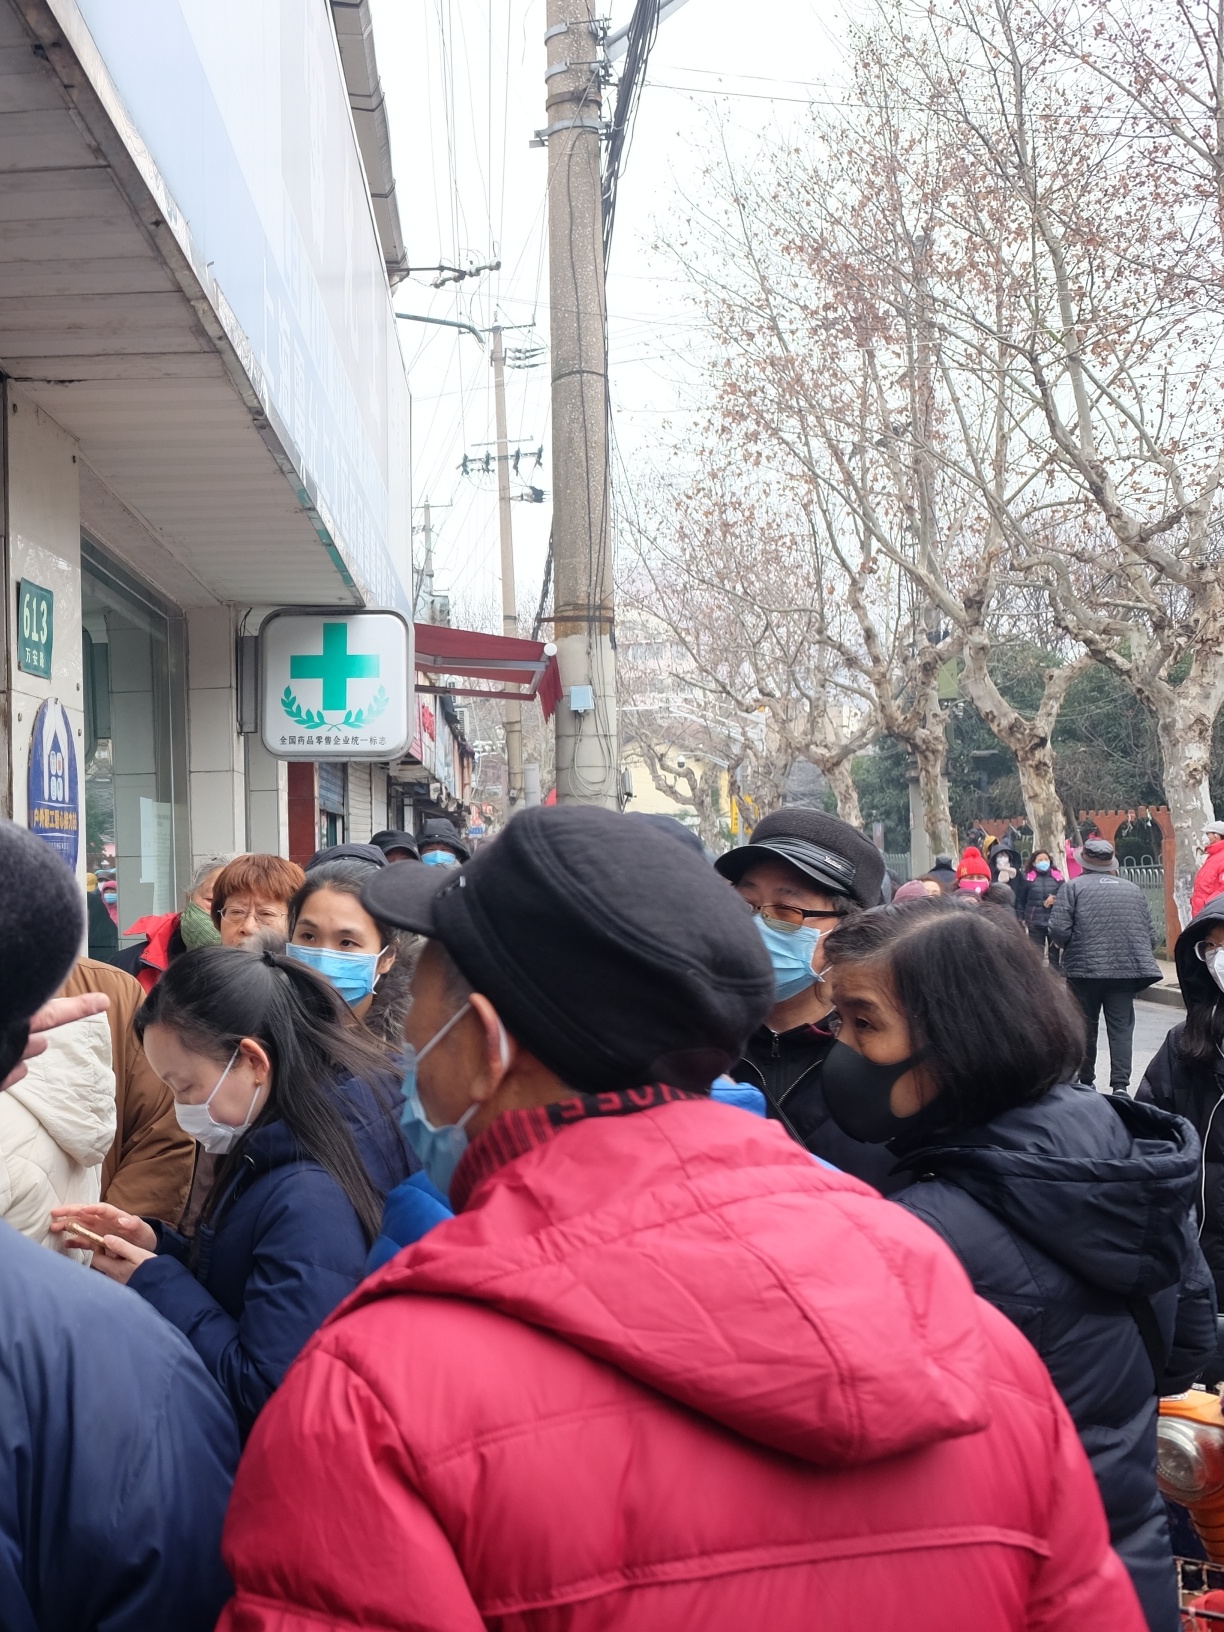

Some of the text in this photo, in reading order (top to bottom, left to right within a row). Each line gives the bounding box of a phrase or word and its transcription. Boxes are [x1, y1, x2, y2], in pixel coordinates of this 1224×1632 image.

[23, 593, 48, 644] 613
[25, 647, 45, 668] 万安路
[278, 734, 387, 746] 全国药品零售企业统一标志
